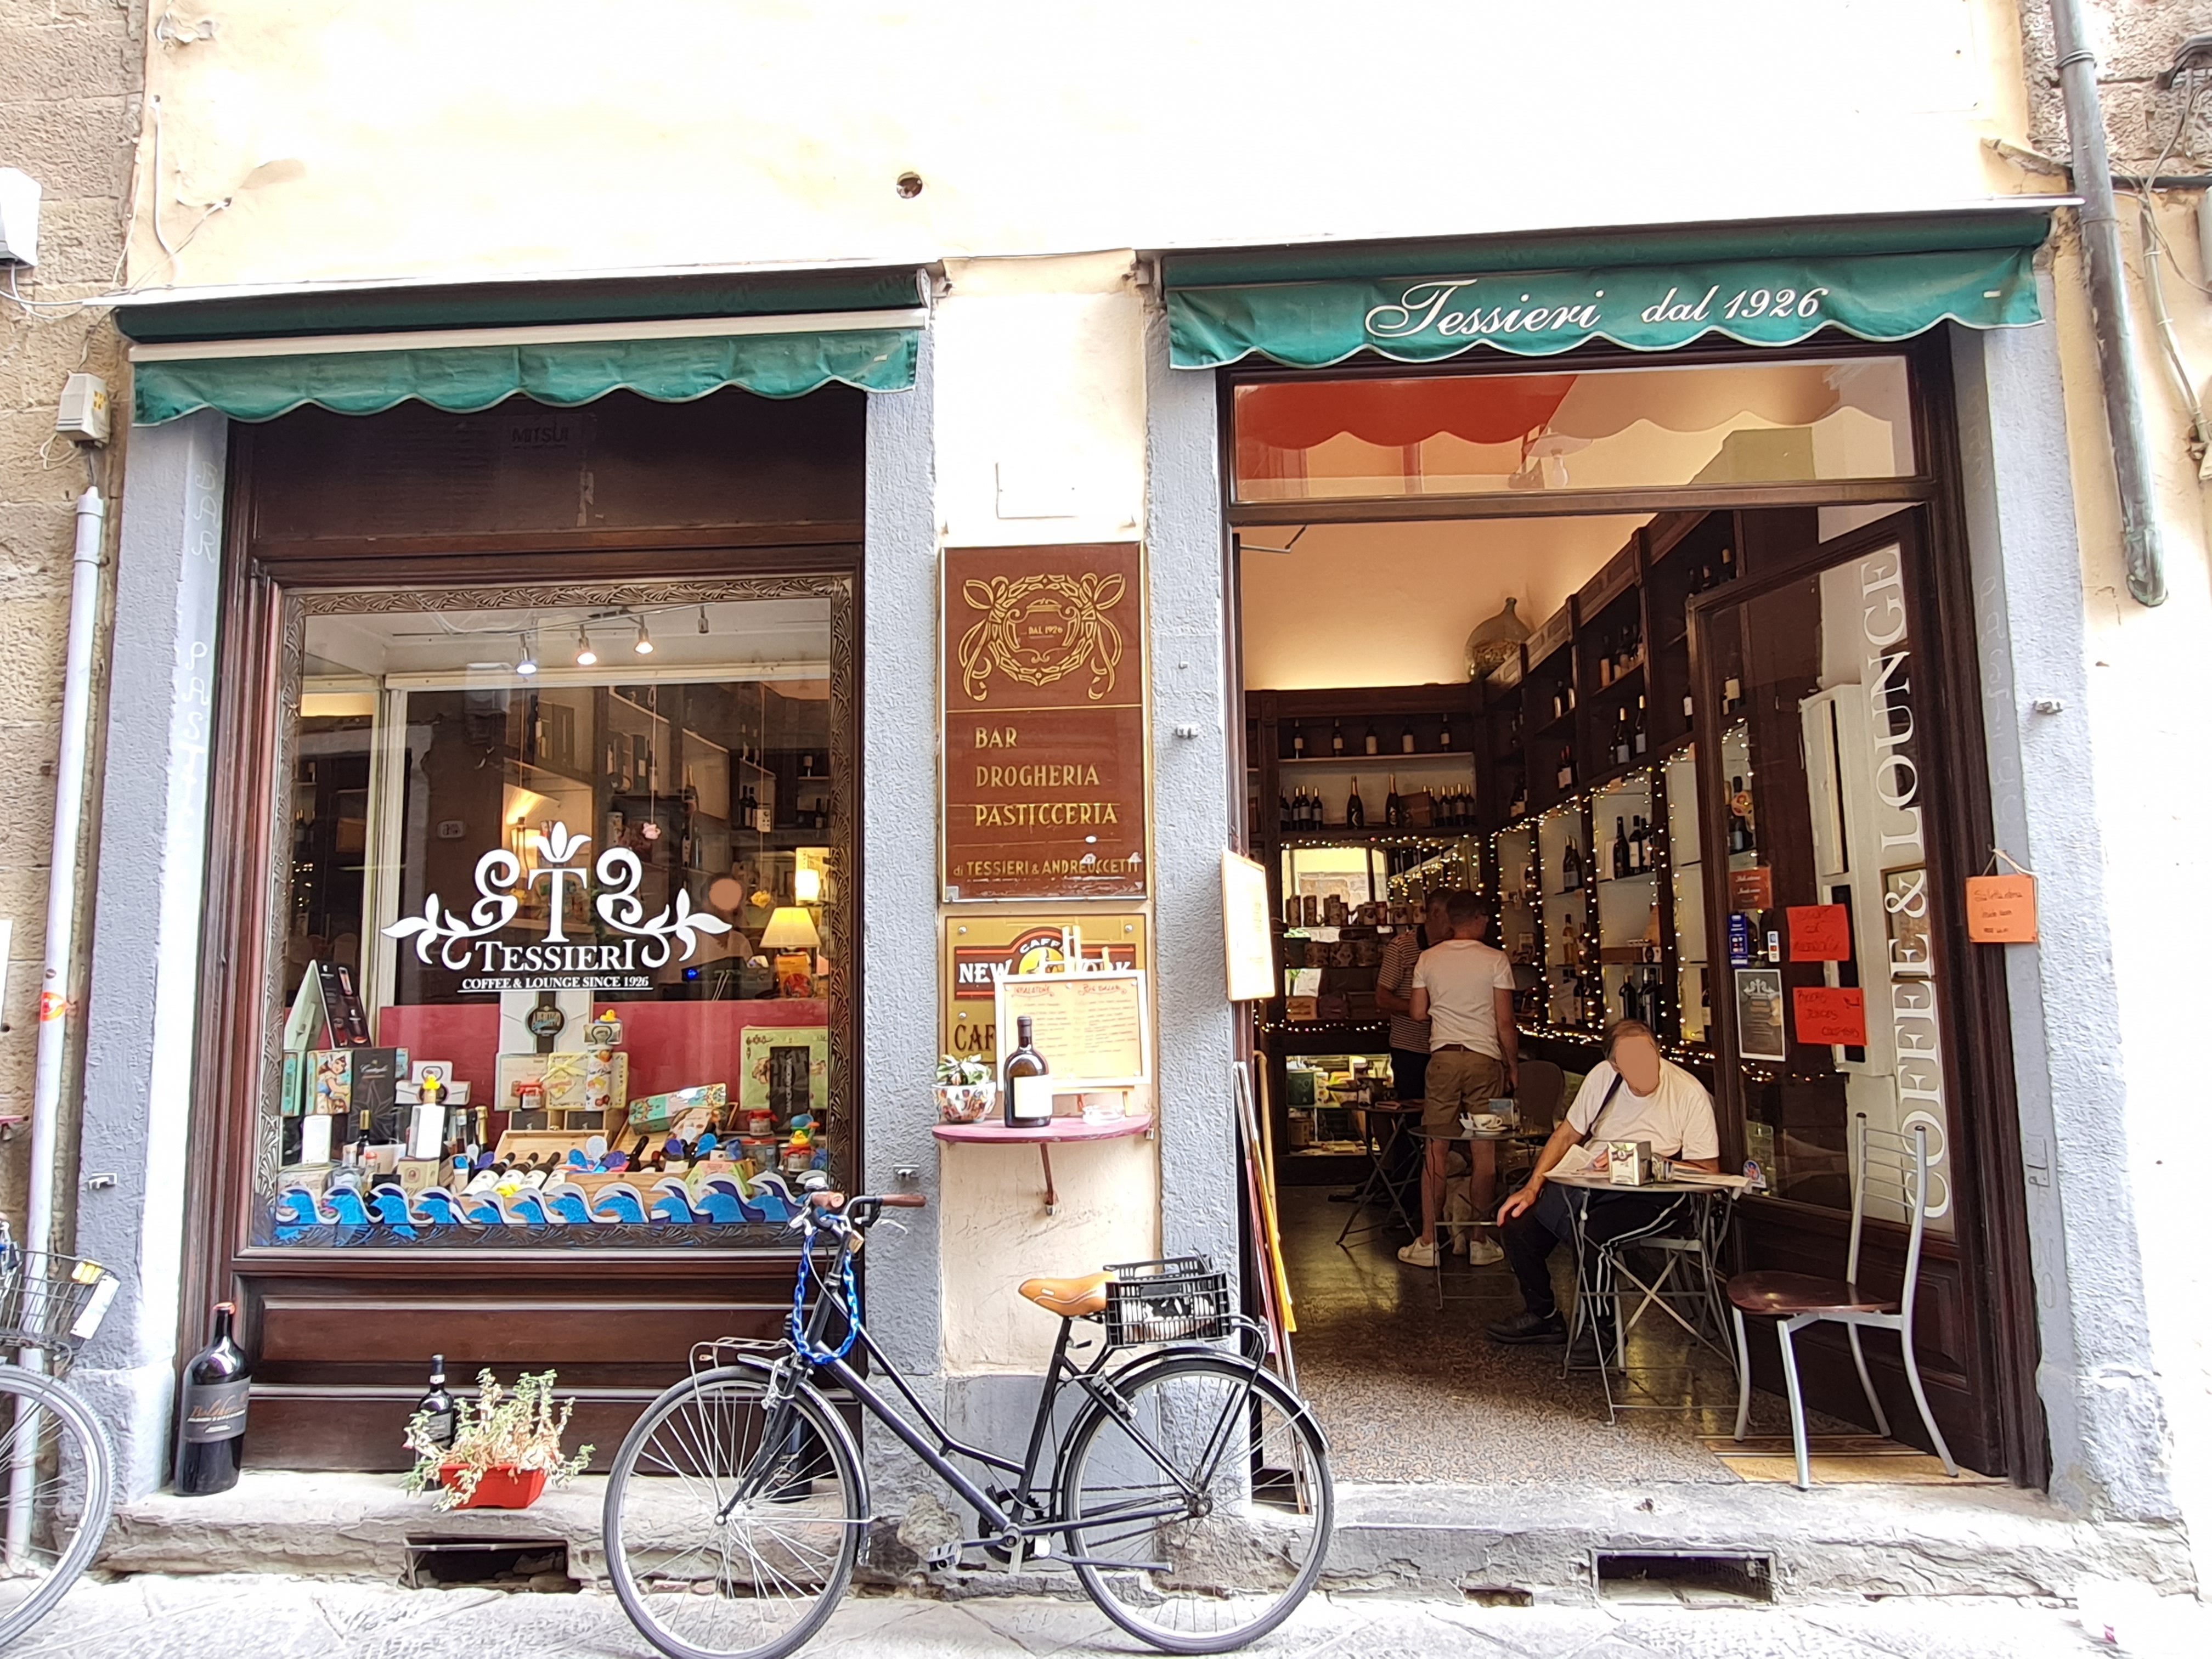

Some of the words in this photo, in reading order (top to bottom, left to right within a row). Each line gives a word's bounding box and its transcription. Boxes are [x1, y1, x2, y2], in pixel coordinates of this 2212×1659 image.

[1365, 279, 1605, 337] Tessieri
[1641, 285, 1721, 323] dal
[1723, 287, 1830, 319] 1926
[1028, 626, 1043, 635] DAL
[1860, 549, 1923, 854] LOUNGE
[974, 727, 1018, 748] BAR
[975, 764, 1101, 787] DROGHERIA
[974, 803, 1118, 826] PASTICCERIA
[953, 865, 964, 876] di
[966, 860, 1029, 876] TESSIERI
[1031, 864, 1040, 873] &
[1886, 869, 1927, 919] &
[475, 939, 637, 972] TESSIERI
[958, 958, 1012, 983] NEW
[462, 978, 511, 990] COFFEE
[512, 979, 522, 989] &
[525, 977, 580, 989] LOUNGE
[582, 977, 621, 988] SINCE
[623, 976, 649, 988] 1926
[1888, 934, 1950, 1218] COFFEE
